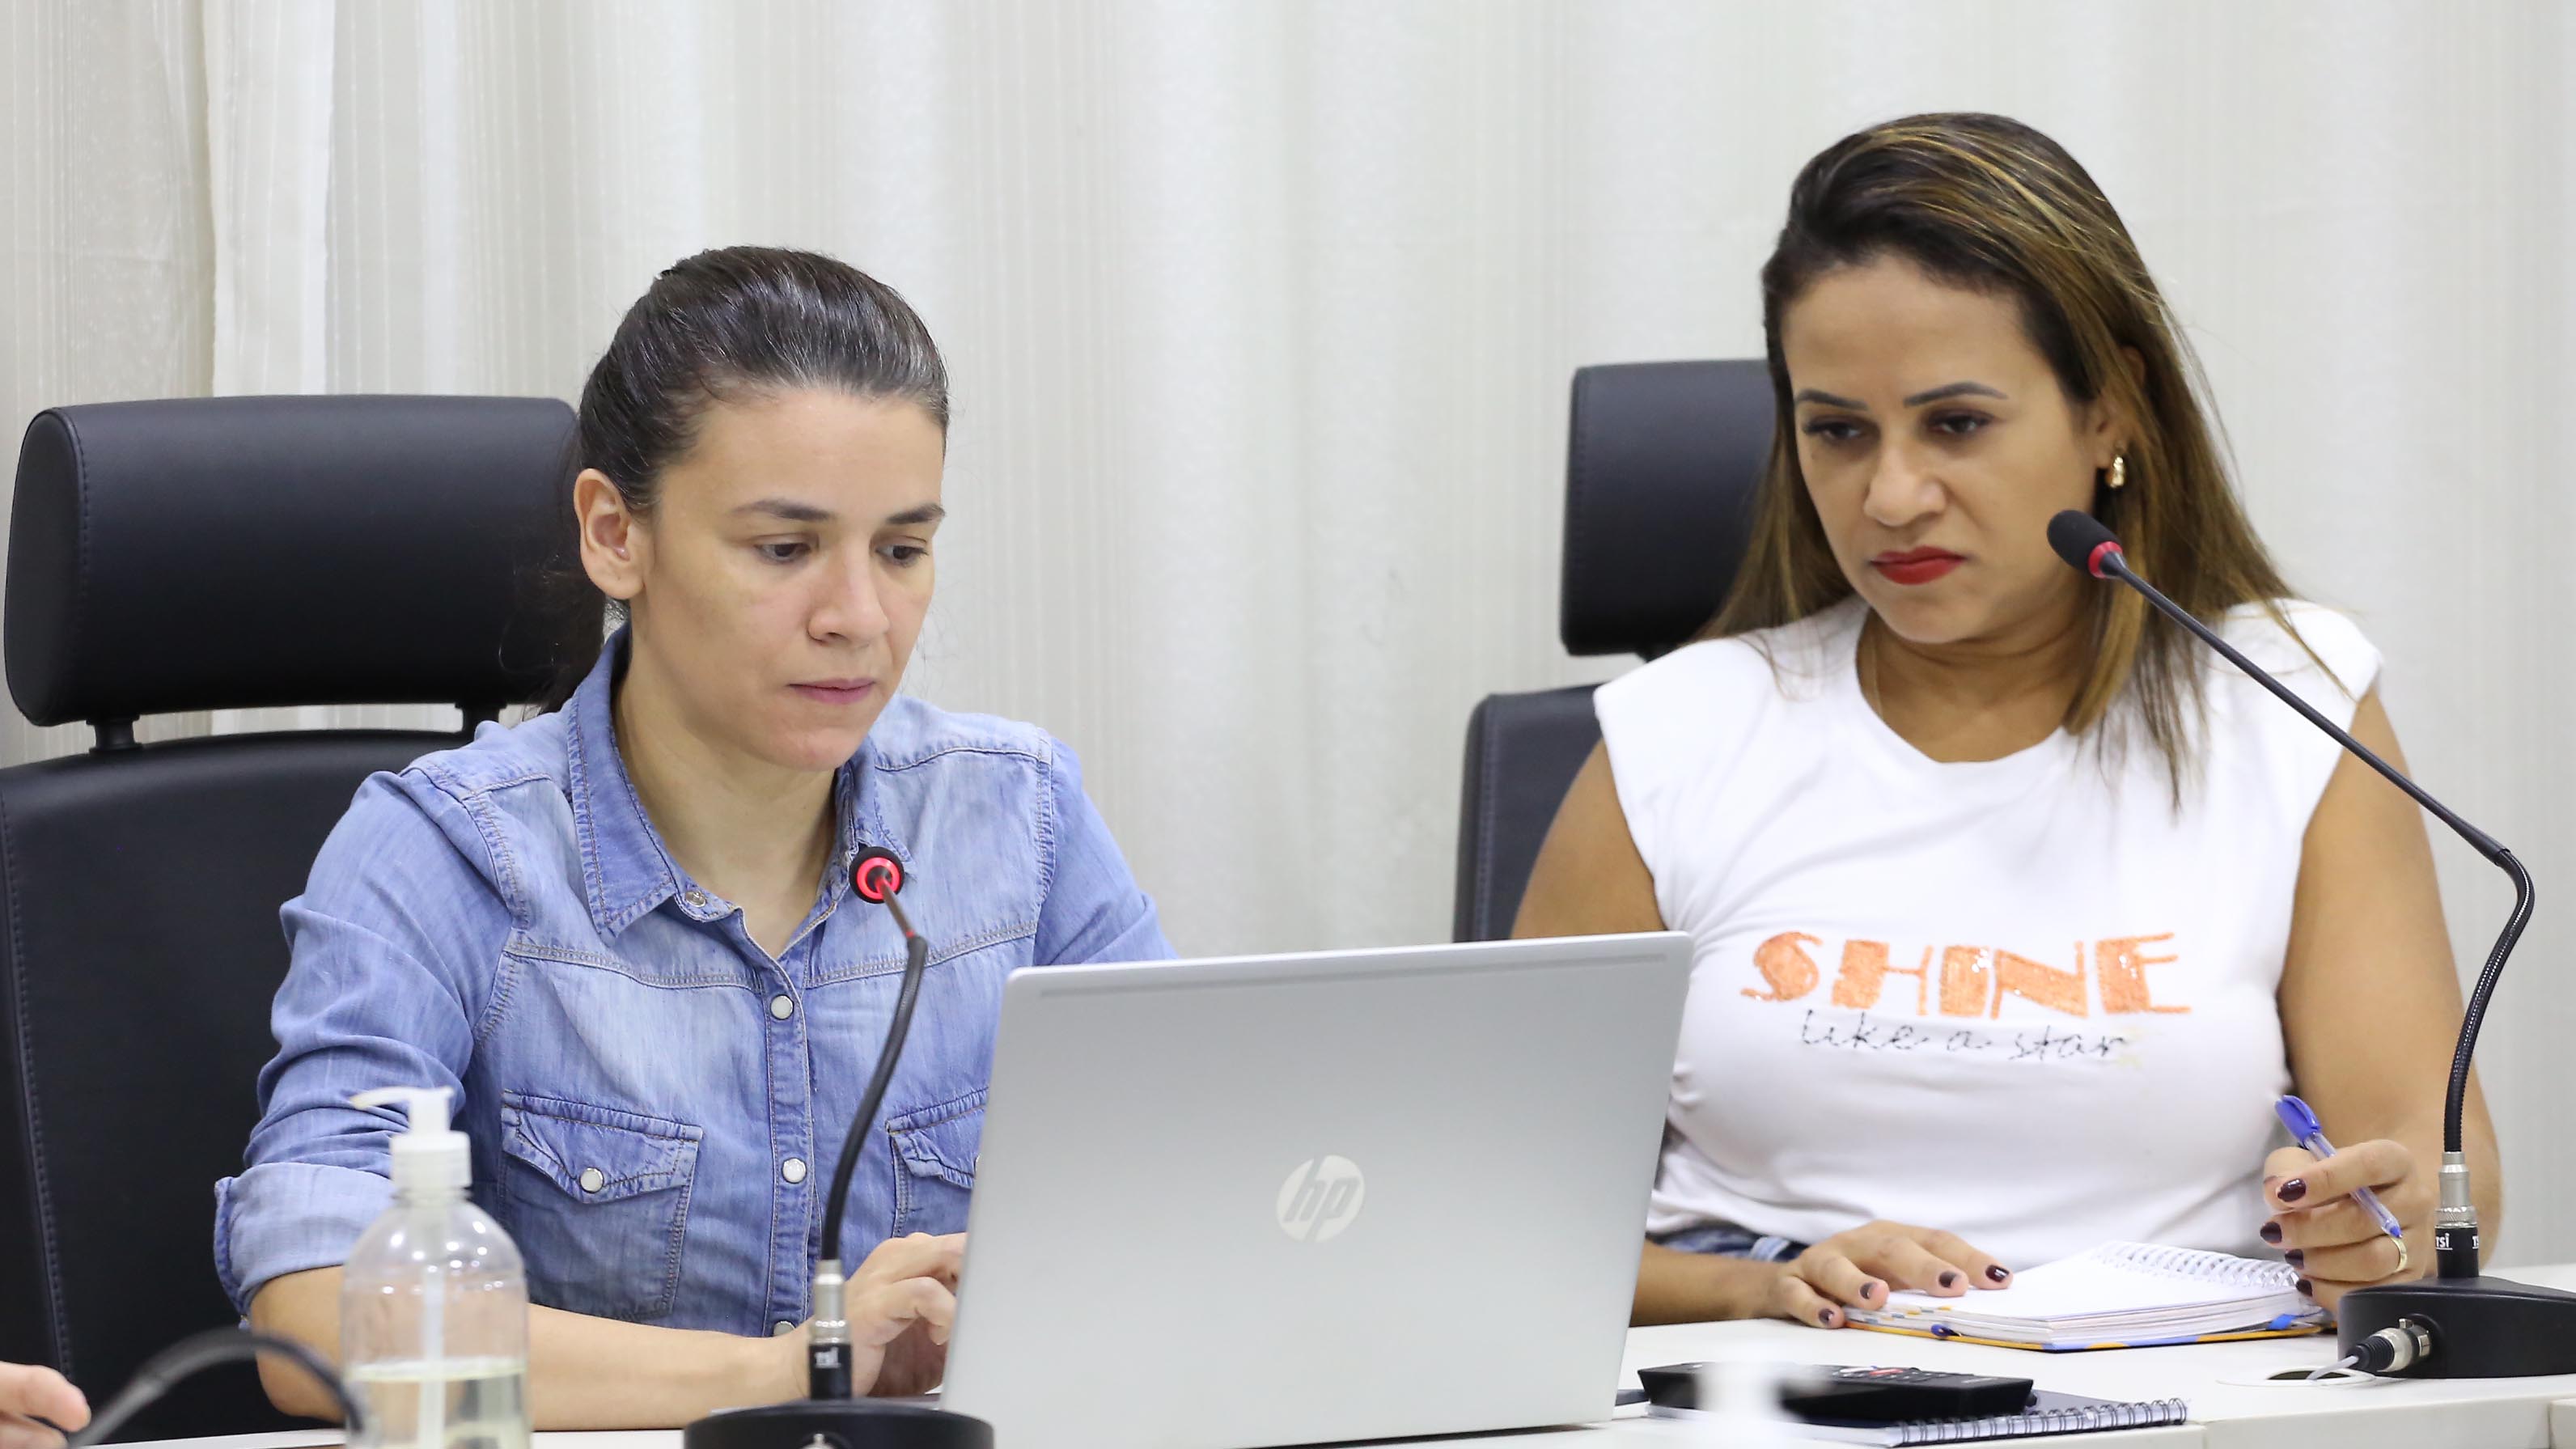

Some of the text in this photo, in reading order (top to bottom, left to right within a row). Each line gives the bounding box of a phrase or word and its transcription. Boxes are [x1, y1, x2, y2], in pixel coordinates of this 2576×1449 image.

[1741, 931, 2192, 1019] SHINE
[1801, 1009, 2128, 1061] like a star
[1282, 1156, 1361, 1242] hp
